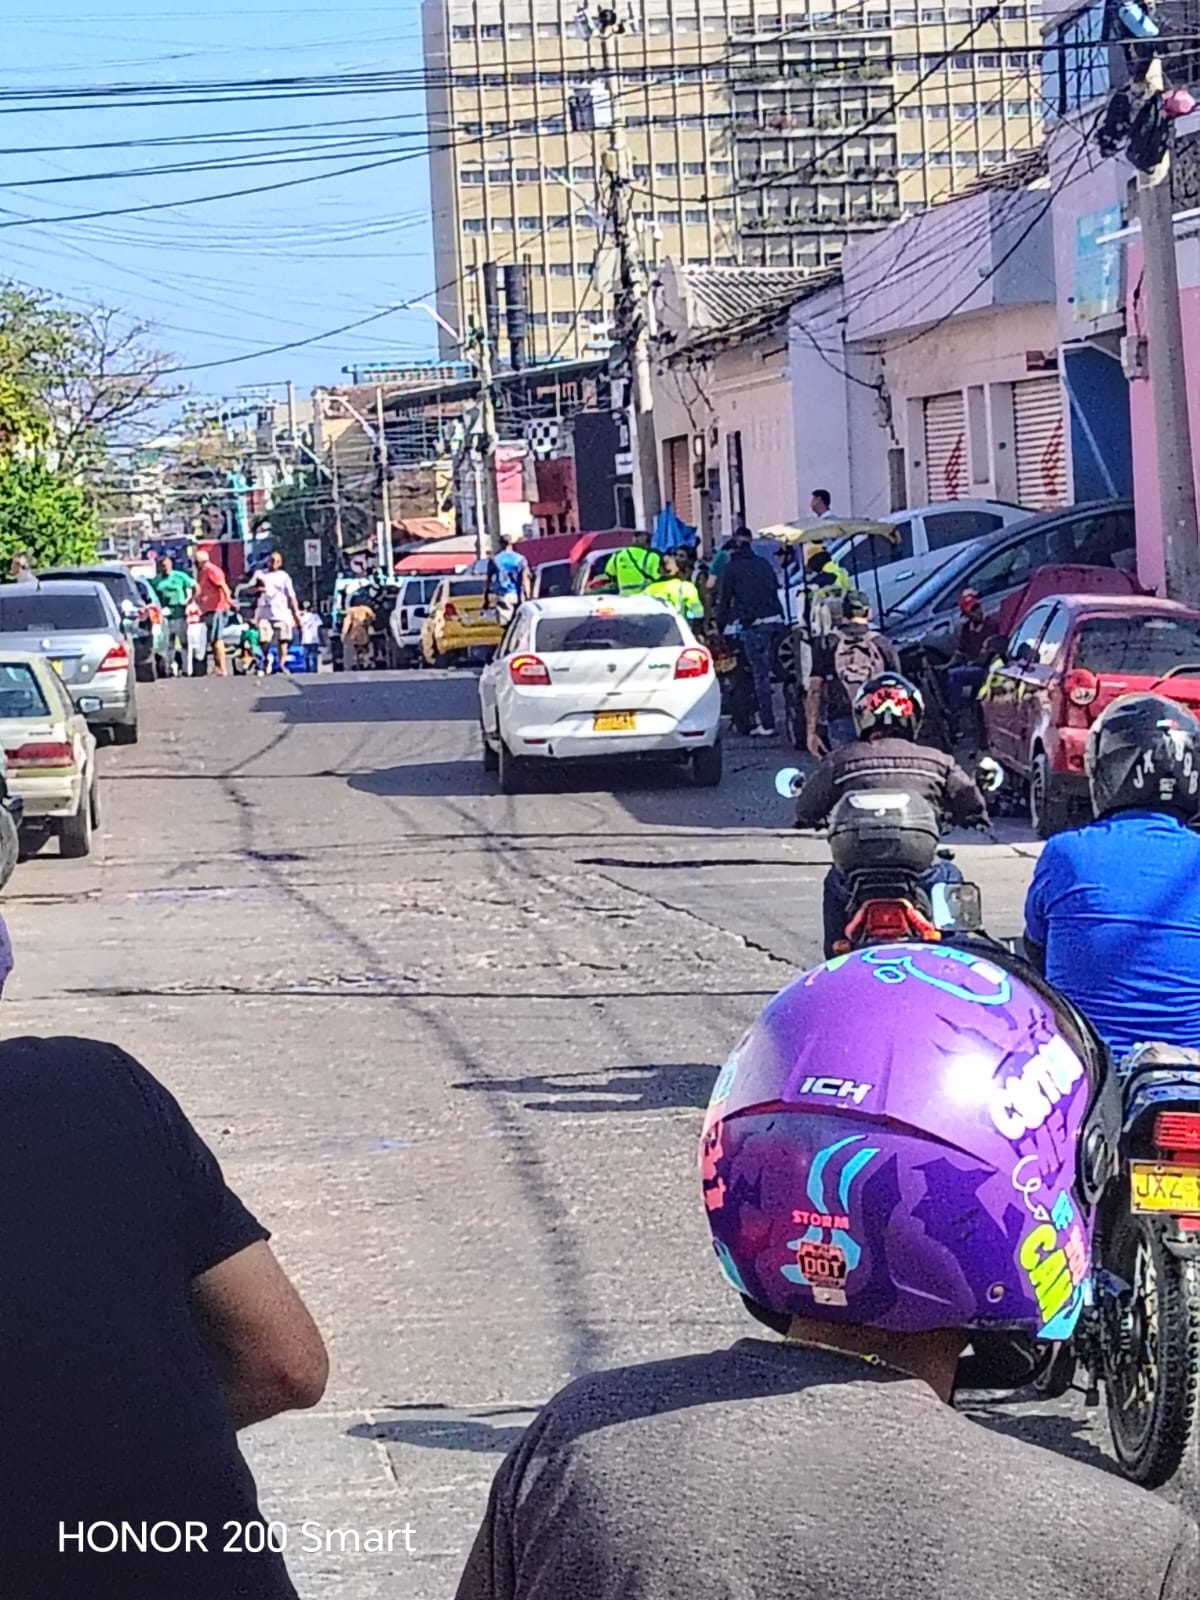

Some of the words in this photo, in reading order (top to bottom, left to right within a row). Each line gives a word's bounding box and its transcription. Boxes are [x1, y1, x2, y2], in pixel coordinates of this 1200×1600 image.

[800, 1077, 873, 1104] ICH
[792, 1210, 850, 1229] STORM
[804, 1257, 840, 1277] DOT
